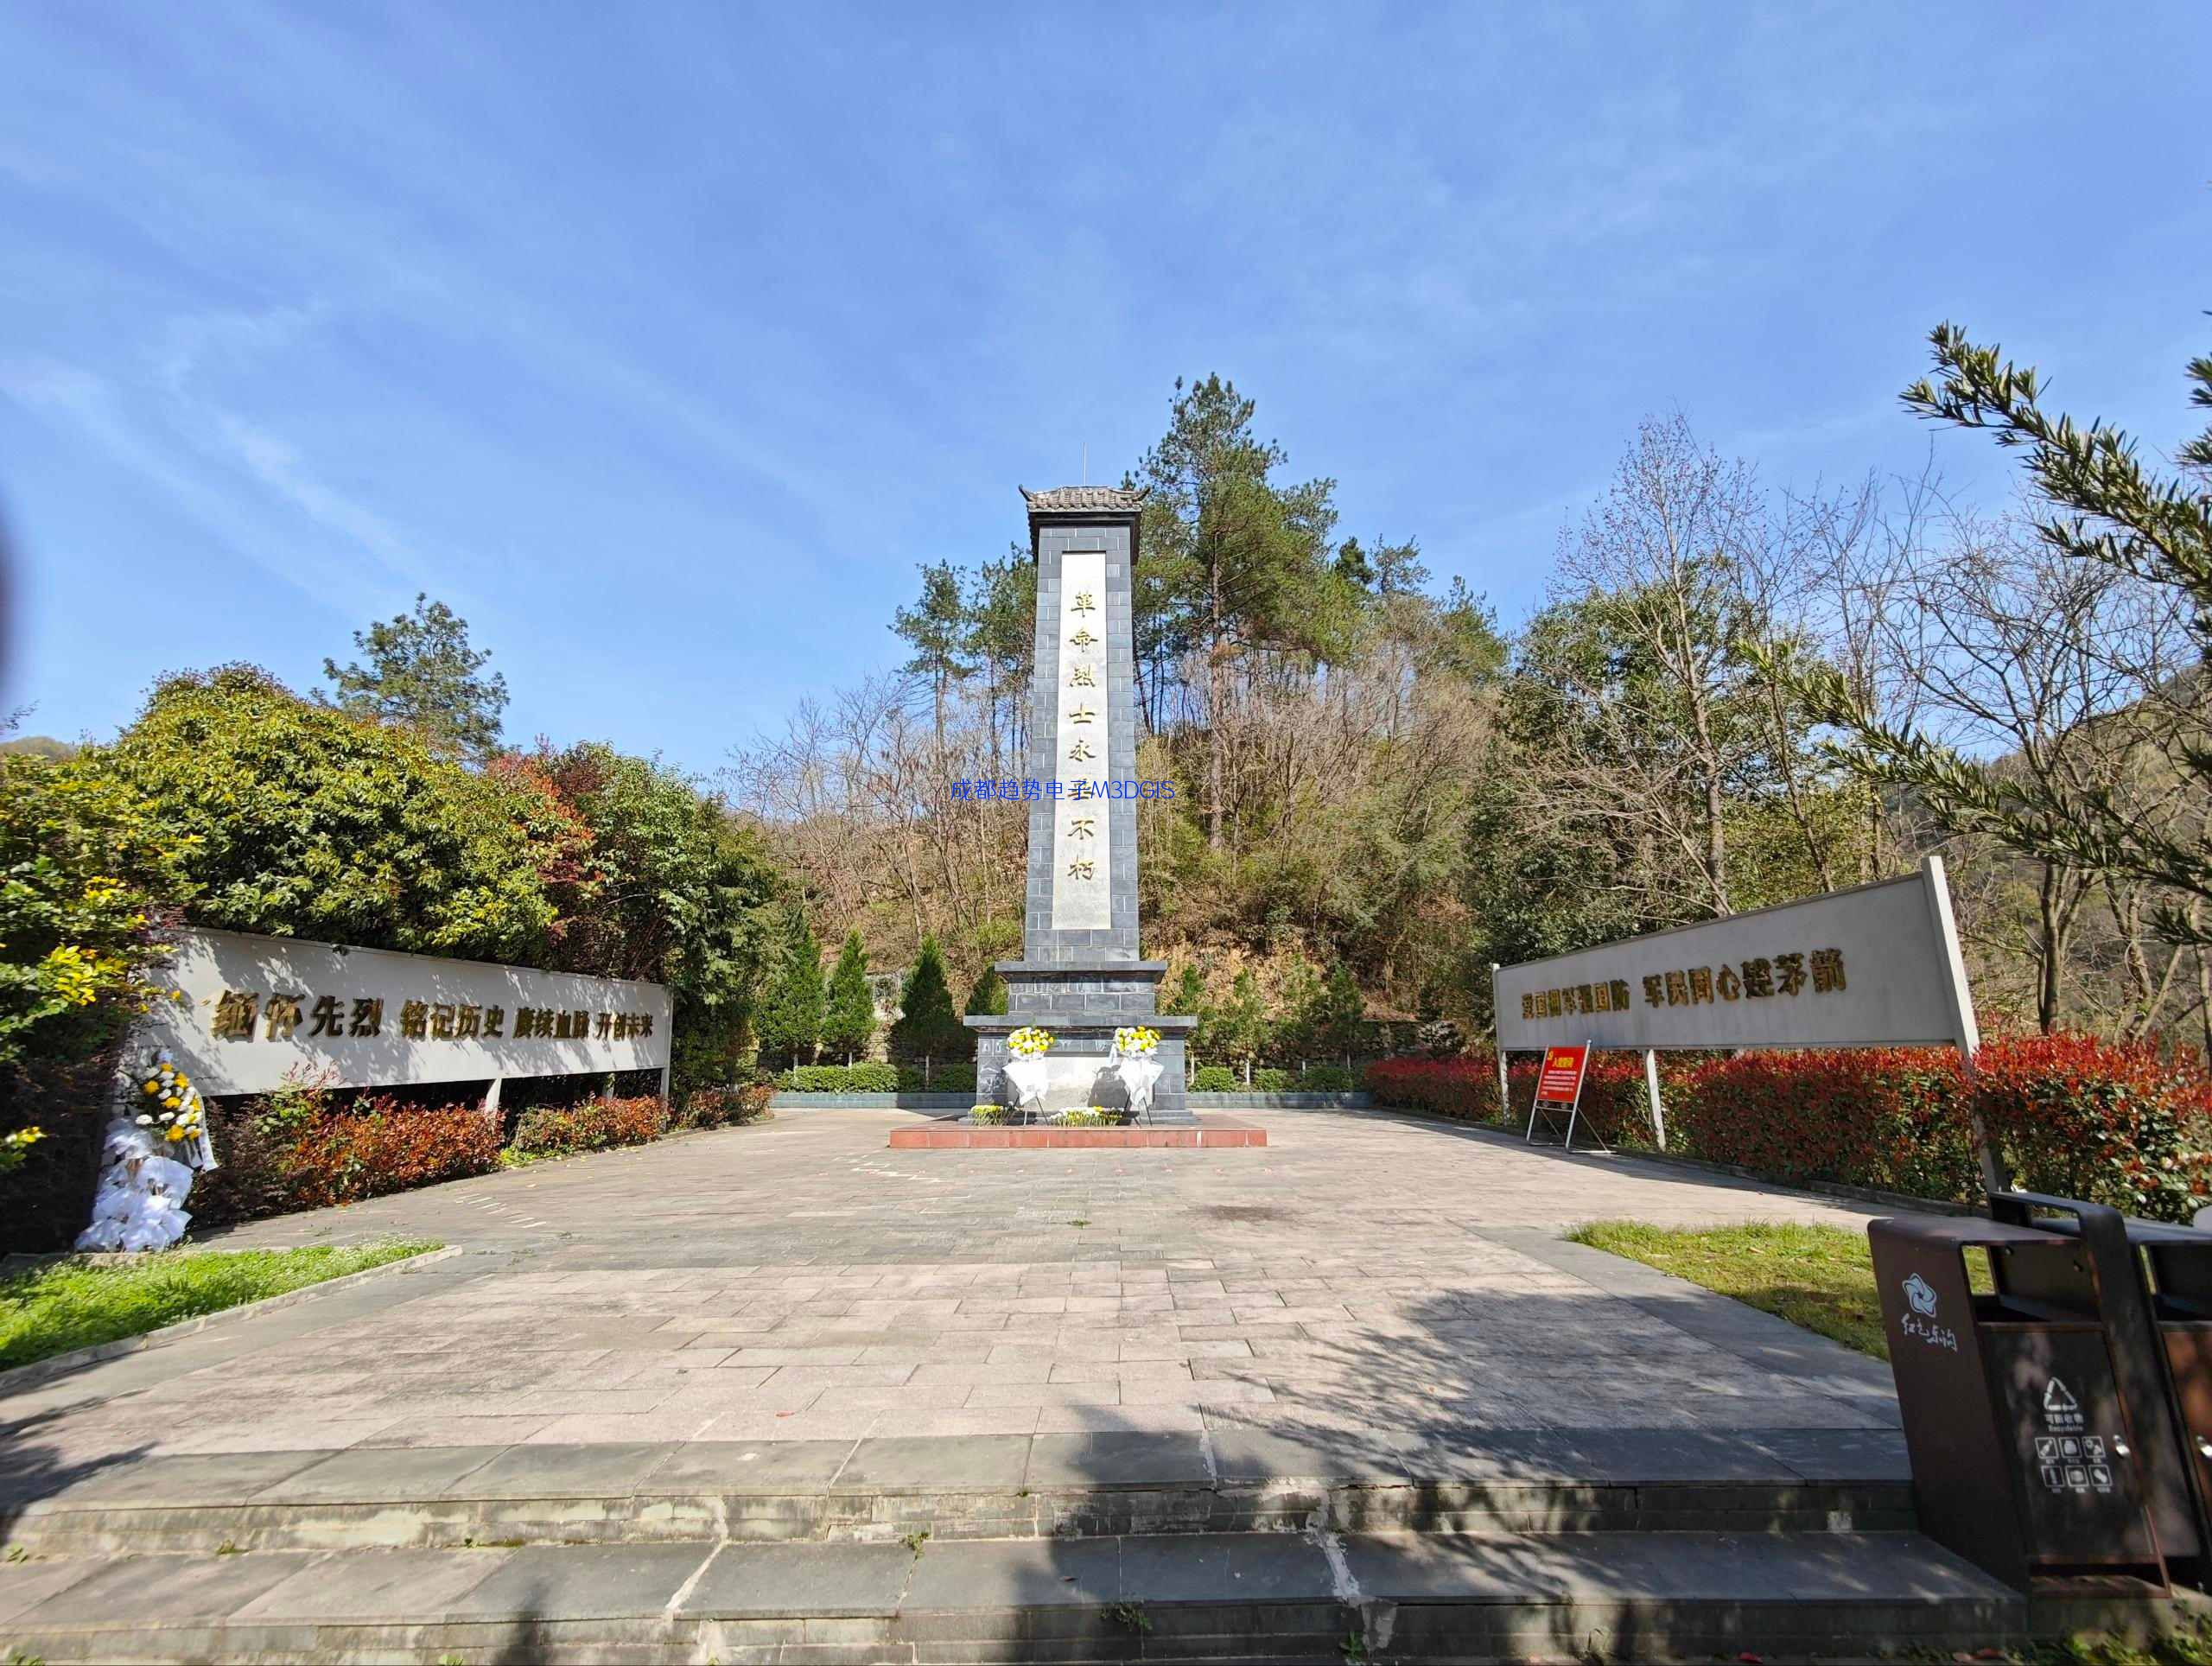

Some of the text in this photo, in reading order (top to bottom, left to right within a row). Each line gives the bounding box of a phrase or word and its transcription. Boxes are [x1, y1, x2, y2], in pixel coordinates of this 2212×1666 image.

[399, 999, 505, 1041] 铭记历史
[595, 1011, 654, 1042] 开创未来
